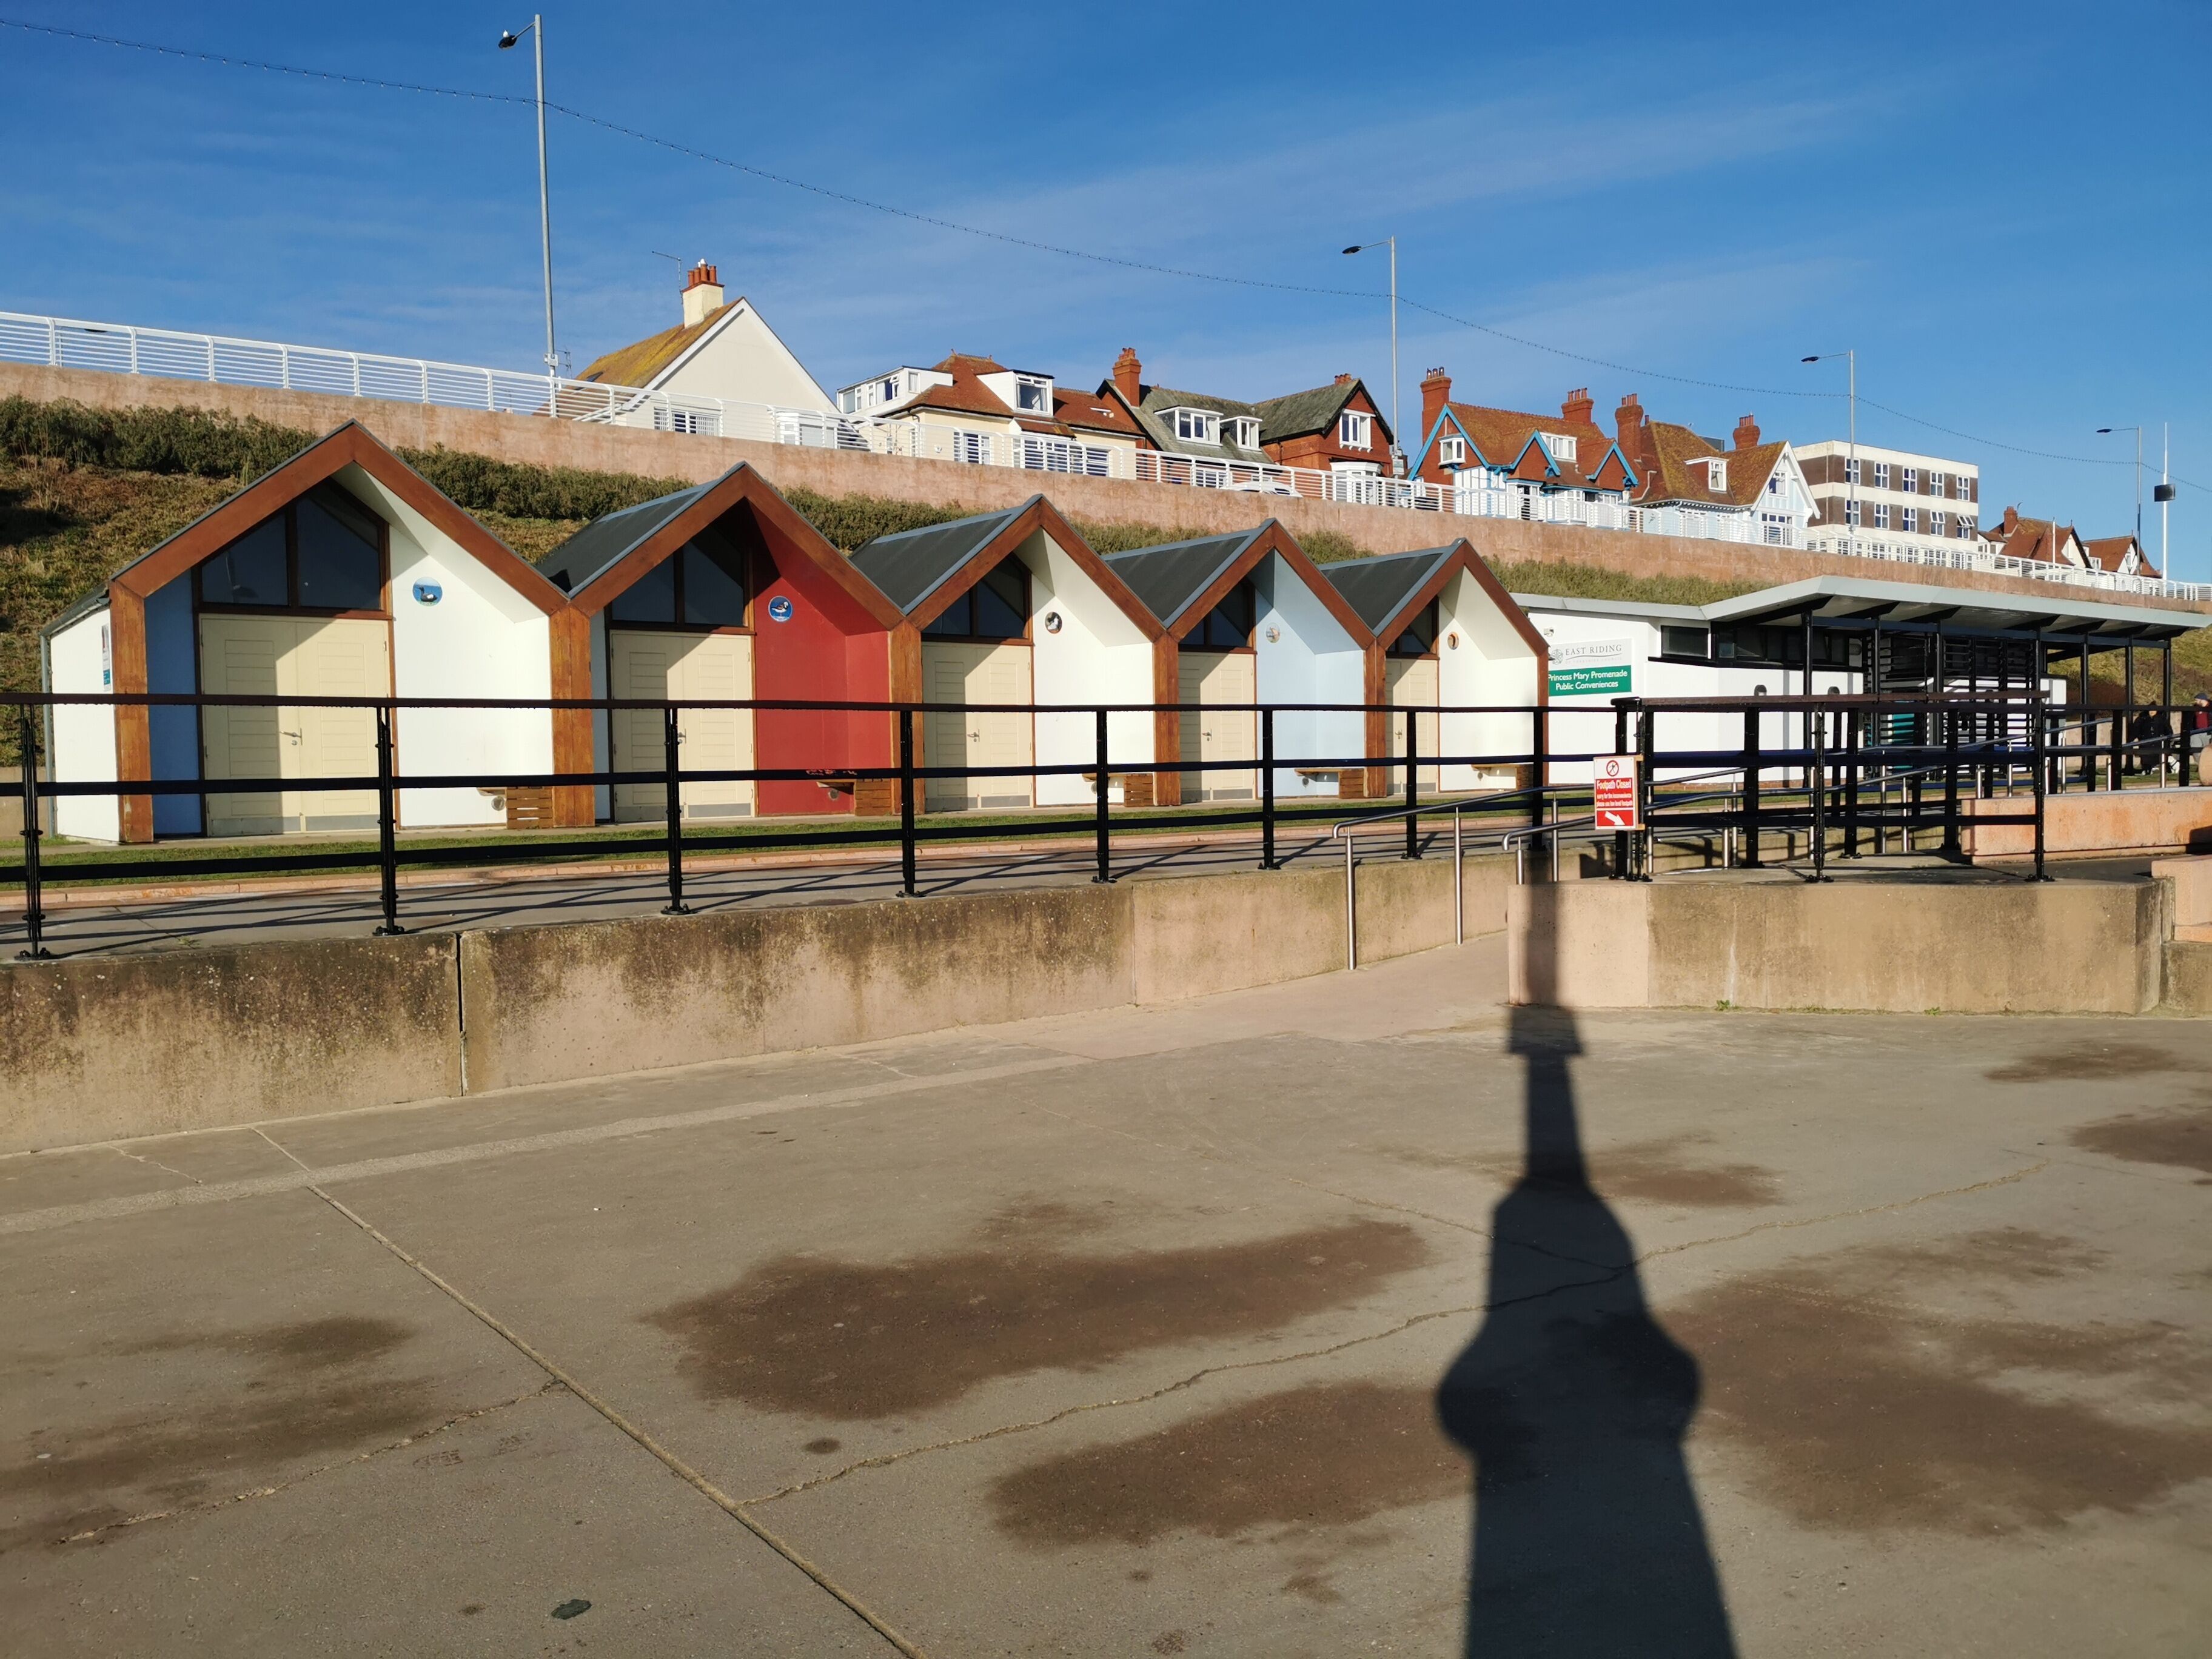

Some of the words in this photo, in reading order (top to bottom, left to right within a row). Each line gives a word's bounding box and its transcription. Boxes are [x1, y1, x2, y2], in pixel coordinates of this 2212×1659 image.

[1565, 647, 1586, 655] EAST
[1590, 644, 1622, 654] RIDING
[1573, 672, 1590, 681] Mary
[1591, 669, 1628, 679] Promenade
[1555, 682, 1574, 691] Public
[1575, 680, 1619, 689] Conveniences
[1597, 780, 1615, 791] Footpath
[1616, 779, 1632, 789] Closed
